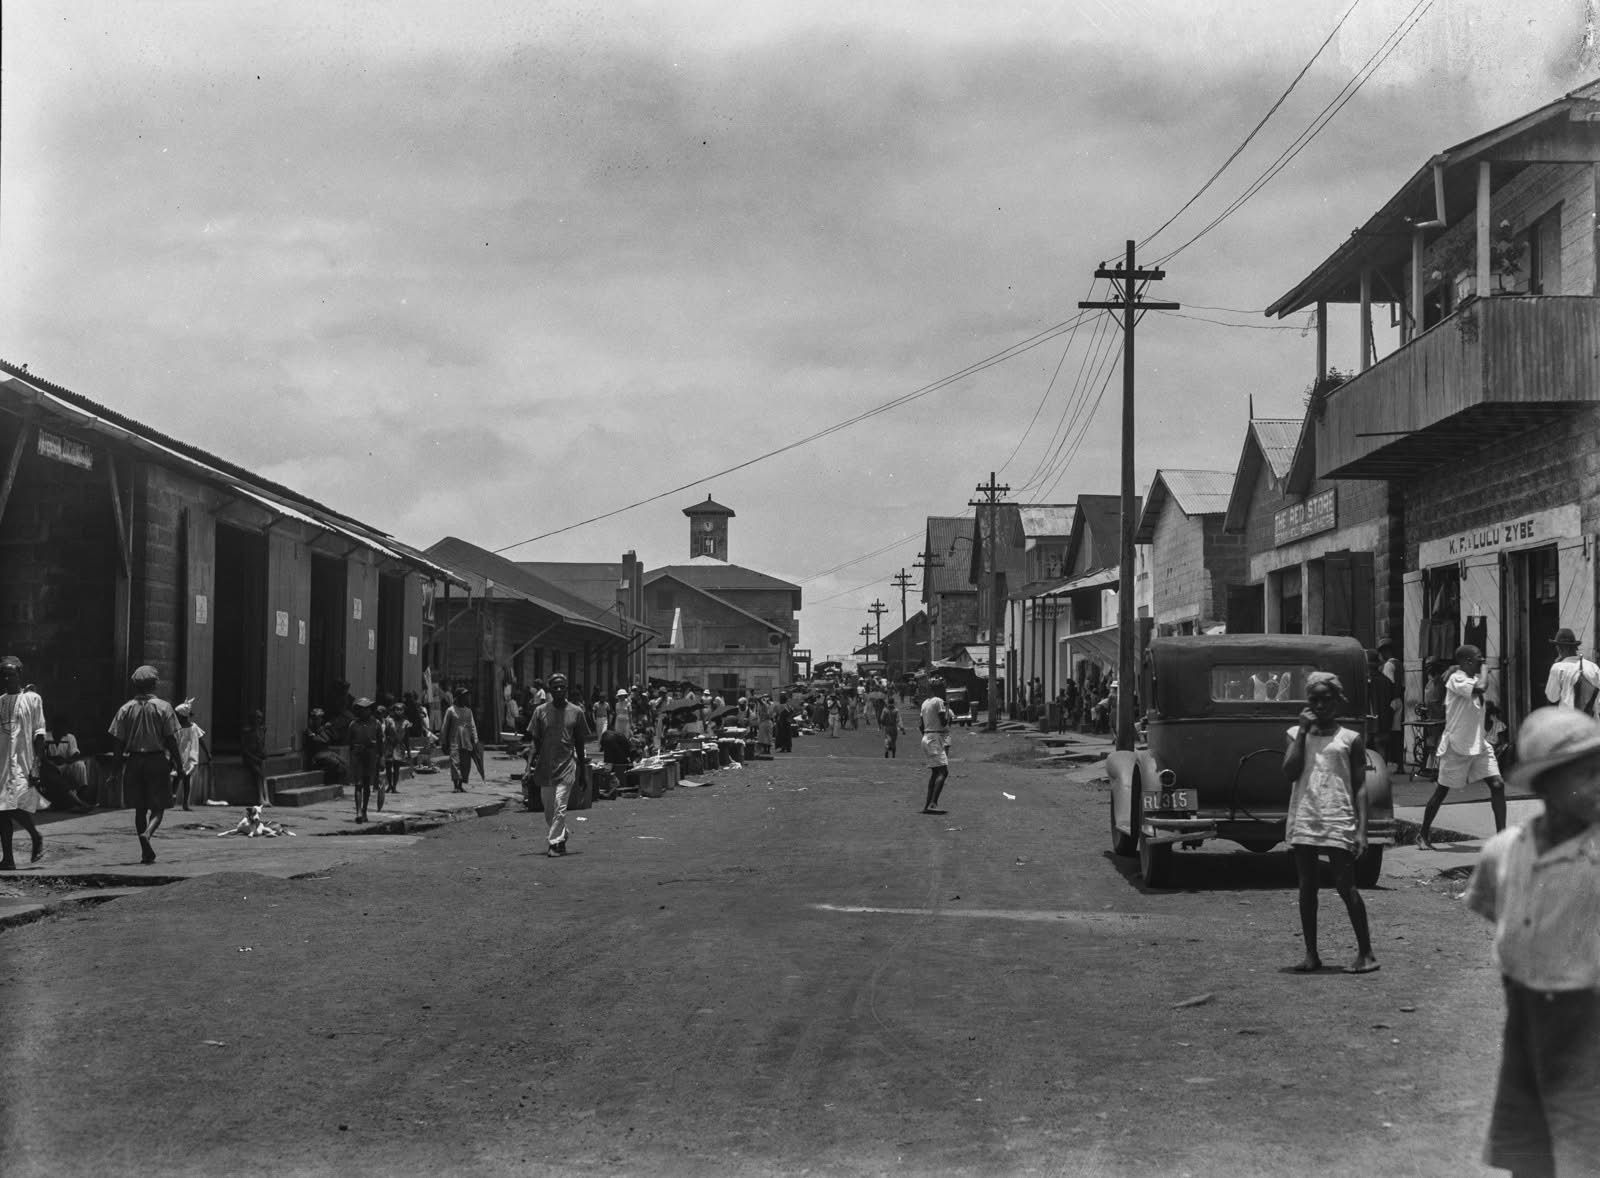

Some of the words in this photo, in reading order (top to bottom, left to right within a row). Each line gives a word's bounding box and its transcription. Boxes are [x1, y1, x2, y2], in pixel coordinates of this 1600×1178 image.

[1275, 511, 1287, 529] THE
[1290, 504, 1304, 526] RED
[1308, 491, 1334, 518] STORE
[1474, 528, 1500, 549] LULU
[1505, 520, 1534, 542] ZYBE
